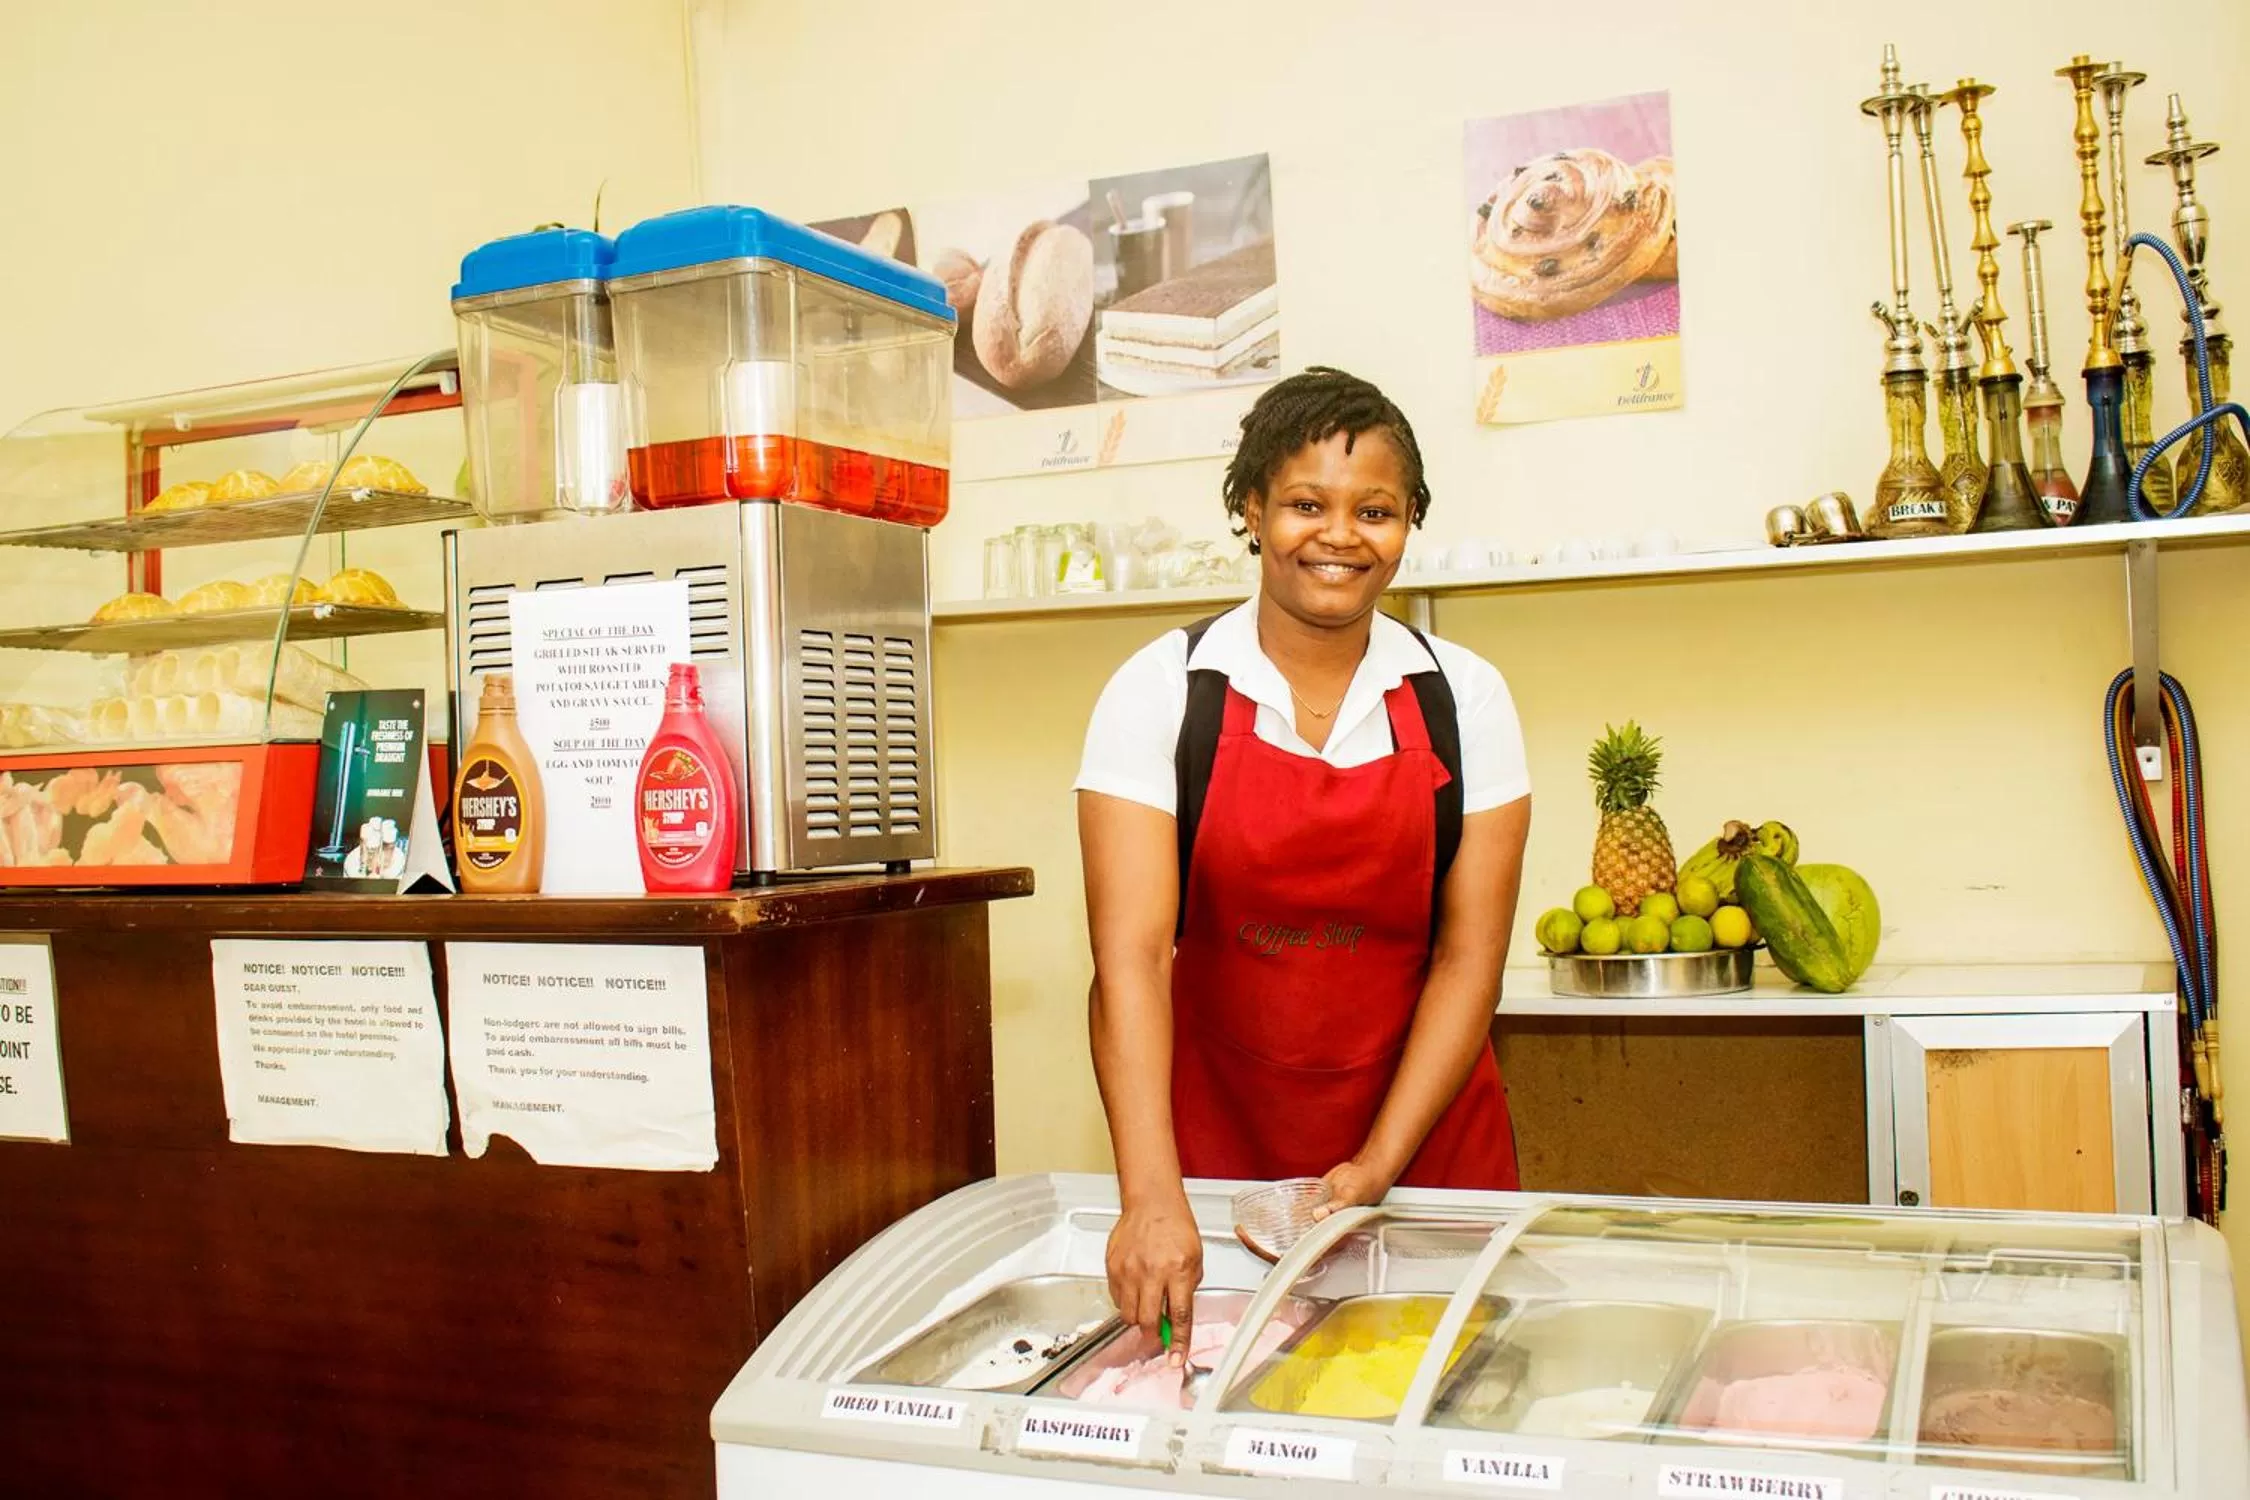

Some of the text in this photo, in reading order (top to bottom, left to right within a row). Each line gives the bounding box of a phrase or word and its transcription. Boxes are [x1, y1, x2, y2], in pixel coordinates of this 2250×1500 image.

[1891, 503, 1935, 517] BREAK
[542, 627, 584, 639] SPECIAL
[607, 625, 627, 636] THE
[631, 624, 655, 635] DAY
[534, 643, 666, 659] GRILLED STEAK SERVED
[558, 662, 641, 674] WITH ROASTED
[550, 698, 570, 708] AND
[573, 697, 609, 707] GRAVY
[554, 737, 646, 749] SOUP OF THE DAY
[572, 759, 594, 769] AND
[585, 775, 612, 785] SOUP
[461, 795, 517, 818] HERSHEY'S
[644, 787, 709, 811] HERSHEY'S
[243, 963, 405, 978] NOTICE! NOTICE!! NOTICE!!!
[243, 983, 266, 992] DEAR
[482, 973, 667, 991] NOTICE! NOTICE!! NOTICE!!!
[0, 1004, 34, 1023] O BE
[832, 1395, 955, 1421] OREO VANILLA
[1024, 1417, 1136, 1443] RASPBERRY
[1248, 1438, 1318, 1462] MANGO
[1461, 1457, 1551, 1480] VANILLA
[1668, 1470, 1829, 1500] STRAWBERRY
